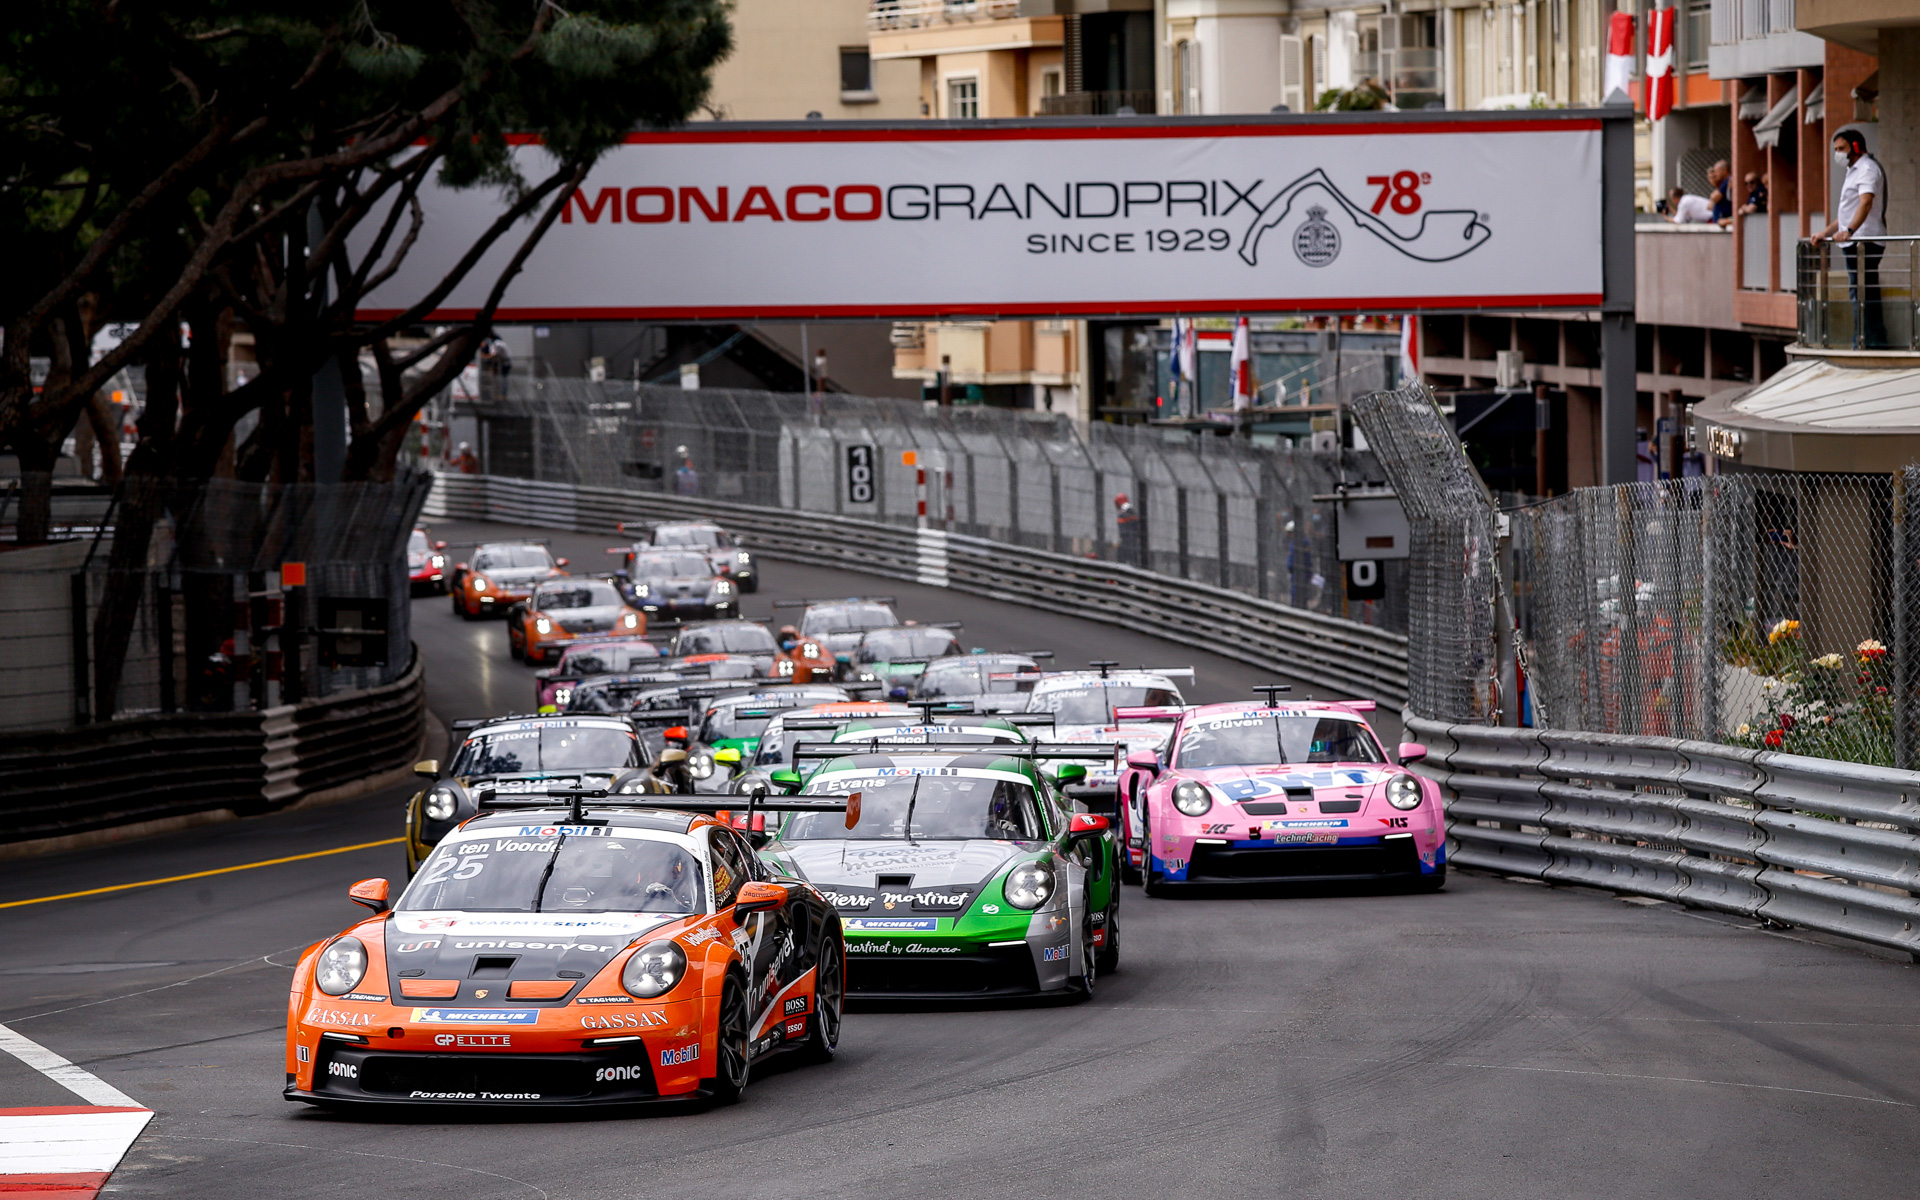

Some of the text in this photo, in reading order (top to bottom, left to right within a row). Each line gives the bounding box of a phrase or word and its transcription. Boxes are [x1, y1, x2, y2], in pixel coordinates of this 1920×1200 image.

[1026, 228, 1231, 254] SINCE 1929
[851, 447, 871, 501] 100
[1352, 560, 1377, 587] 0
[520, 721, 562, 729] Mobil
[1188, 719, 1264, 735] A. Güven
[487, 731, 540, 744] Latorre
[877, 767, 936, 777] Mobil
[807, 778, 887, 797] J. Evans
[519, 825, 588, 836] Mobil
[1287, 820, 1342, 828] MICHELIN
[437, 839, 564, 859] L. ten Voorde
[421, 853, 490, 887] 25
[821, 890, 876, 908] Pierre
[865, 920, 928, 928] MICHELIN
[454, 940, 614, 954] uniserver
[892, 945, 903, 954] by
[784, 996, 805, 1011] BOSS
[302, 1006, 377, 1027] GASSAN
[445, 1011, 529, 1021] MICHELIN
[580, 1009, 670, 1030] GASSAN
[787, 1022, 803, 1034] ESSO
[660, 1045, 691, 1067] Mobil
[408, 1090, 541, 1100] Porsche Twente
